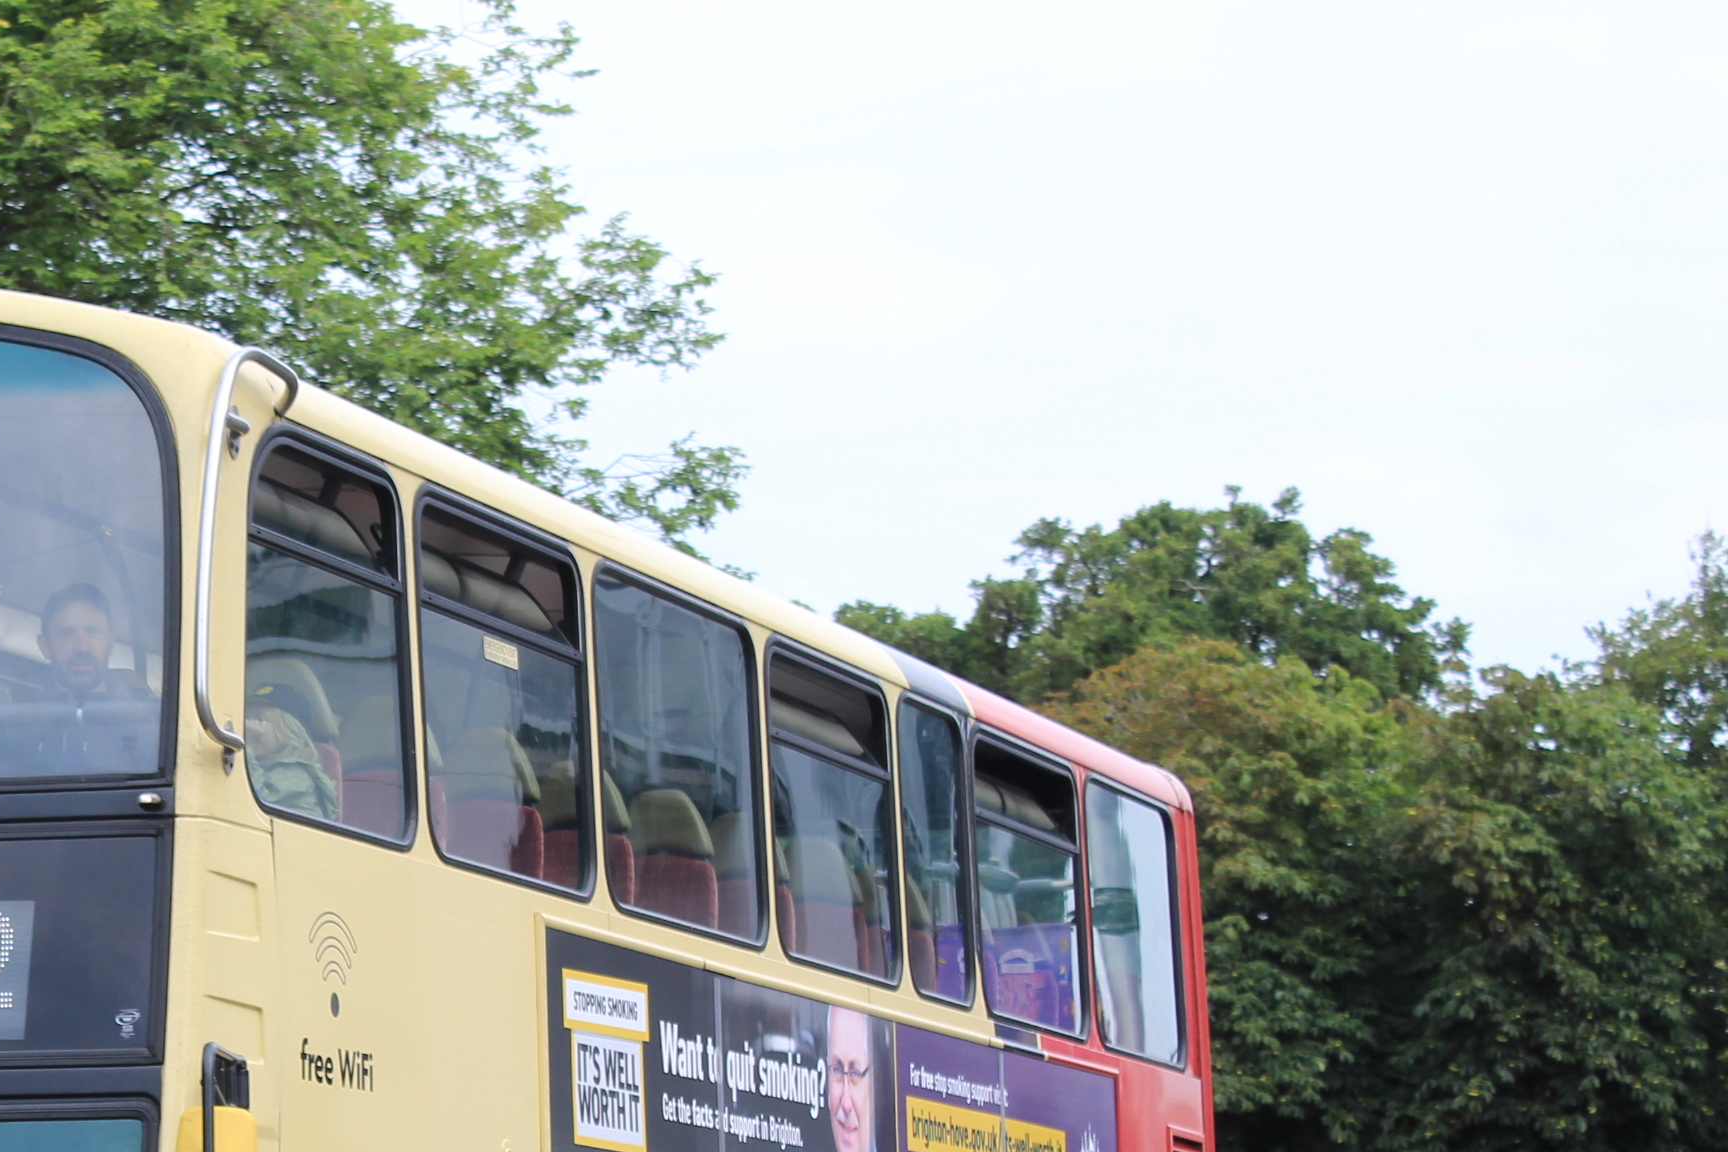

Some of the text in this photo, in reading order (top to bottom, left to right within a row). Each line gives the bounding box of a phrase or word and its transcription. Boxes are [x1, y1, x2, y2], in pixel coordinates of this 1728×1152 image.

[573, 991, 638, 1021] STOPPING SMOKING
[300, 1037, 374, 1092] free WiFi
[577, 1042, 639, 1093] IT'S WELL
[659, 1020, 704, 1081] Want
[726, 1040, 756, 1103] quit
[759, 1052, 826, 1119] smoking?
[910, 1063, 920, 1087] For
[921, 1066, 933, 1091] free
[935, 1072, 946, 1098] stop
[947, 1075, 971, 1104] smoking
[971, 1083, 993, 1107] support
[577, 1083, 640, 1133] WORTH IT
[662, 1093, 803, 1151] Get the facts ad support in Brighton.
